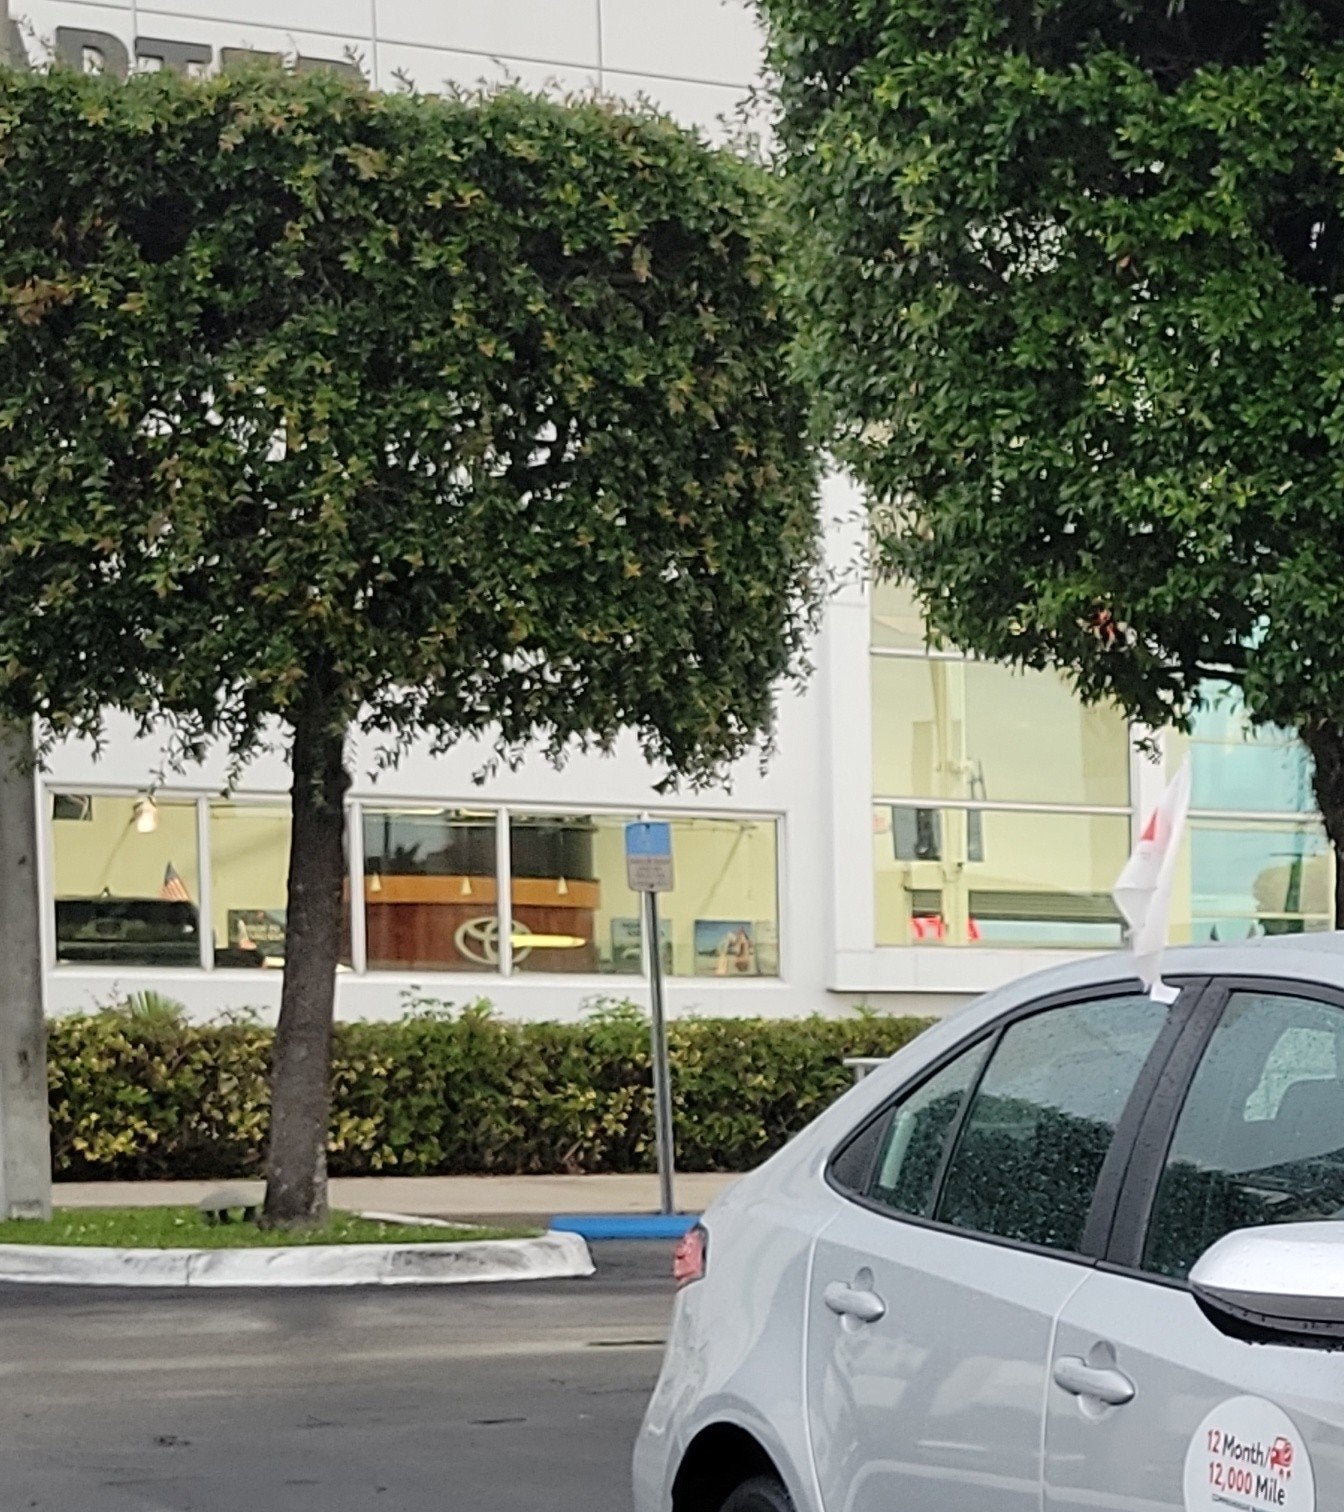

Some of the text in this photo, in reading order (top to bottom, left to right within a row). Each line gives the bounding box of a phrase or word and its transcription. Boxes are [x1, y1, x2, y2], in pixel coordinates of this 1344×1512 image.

[1207, 1429, 1220, 1454] 12
[1209, 1461, 1286, 1506] 12,000 Mile
